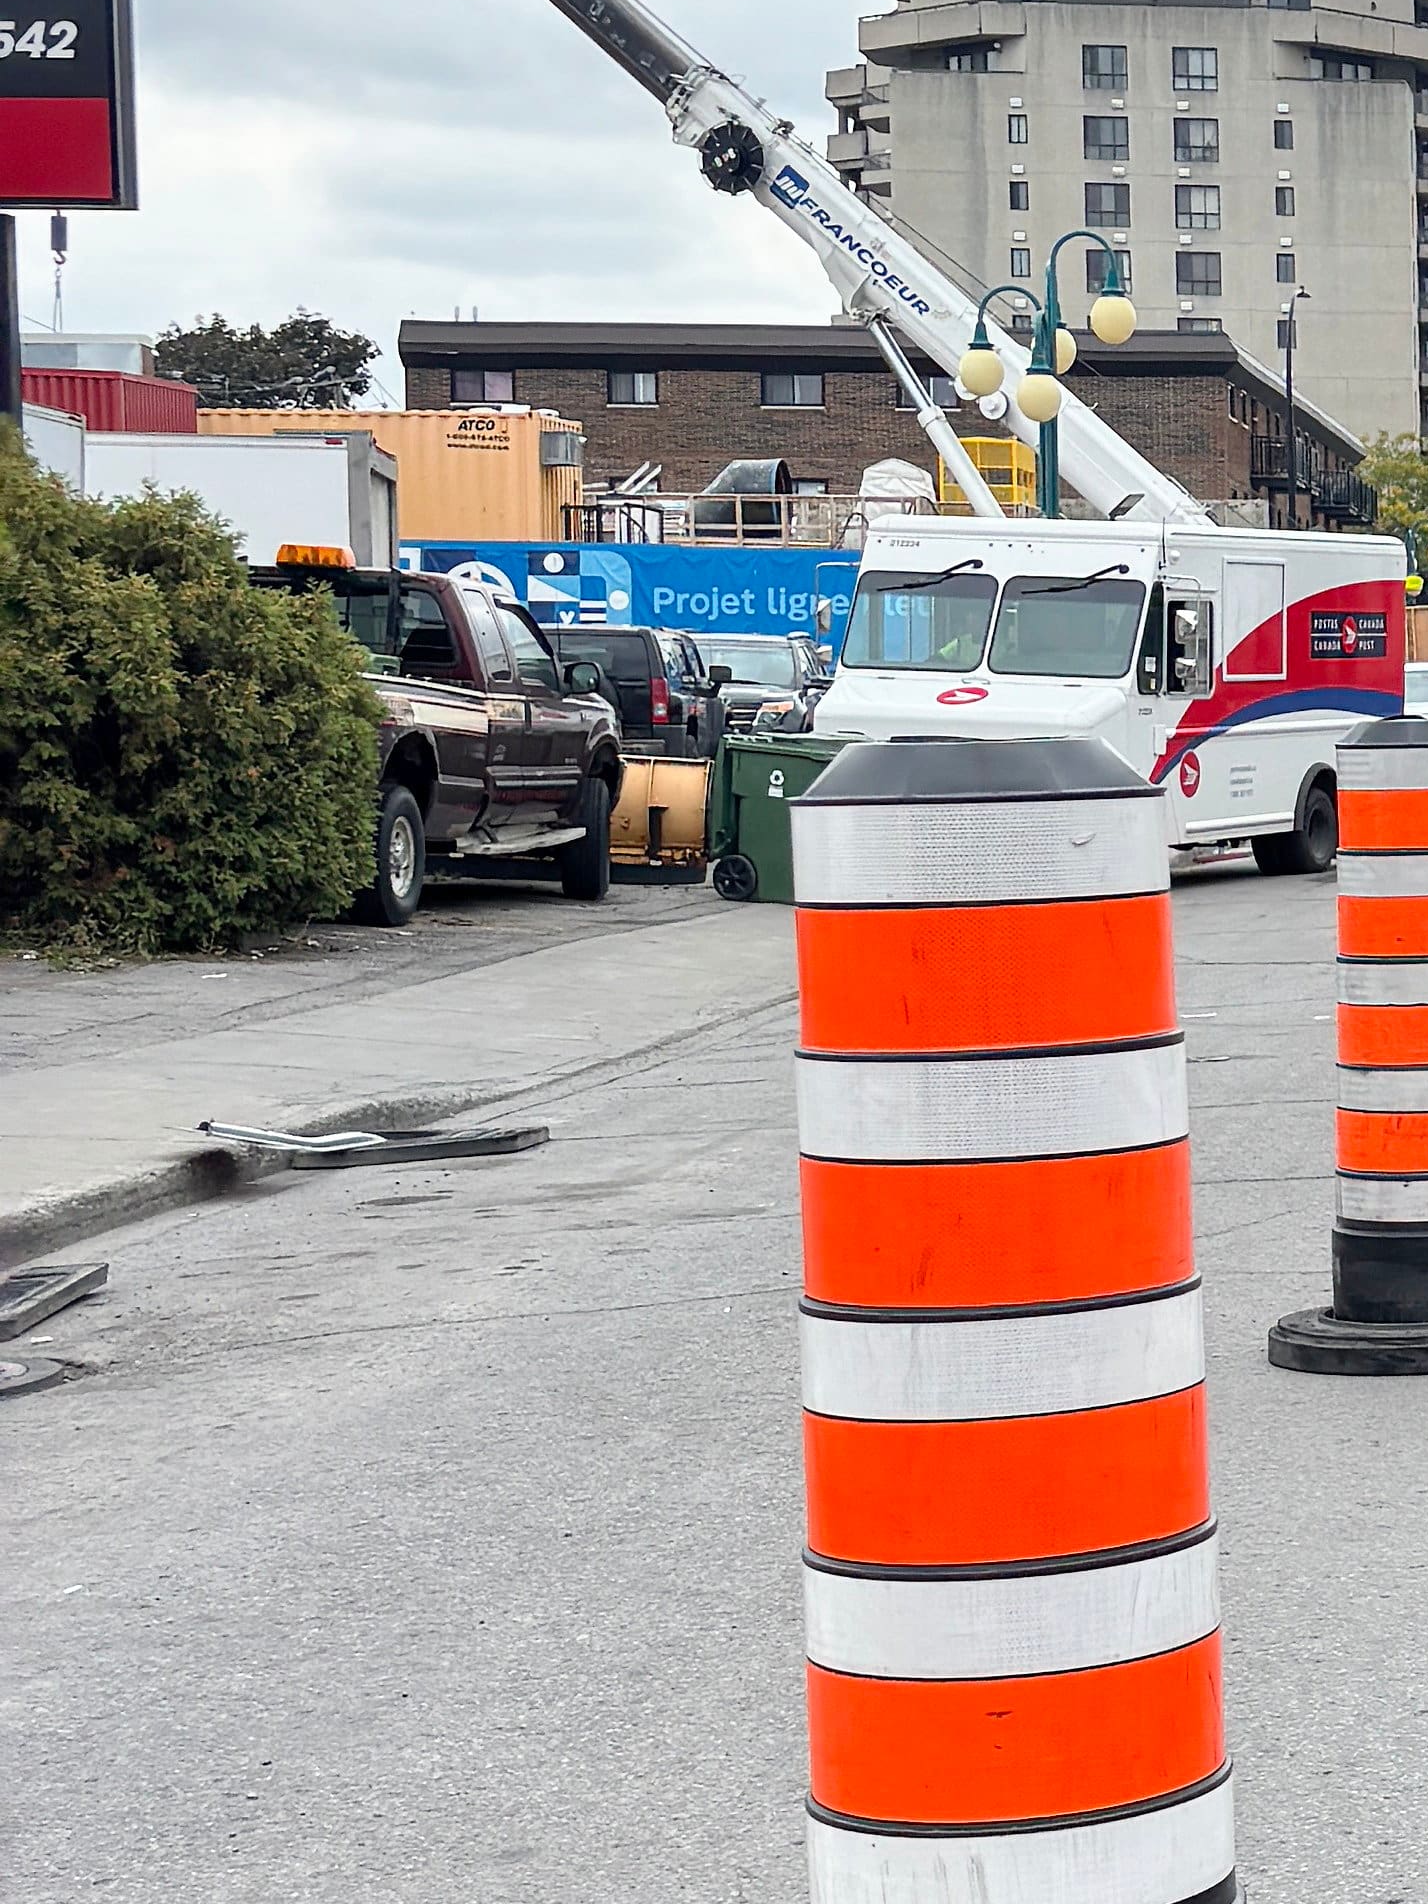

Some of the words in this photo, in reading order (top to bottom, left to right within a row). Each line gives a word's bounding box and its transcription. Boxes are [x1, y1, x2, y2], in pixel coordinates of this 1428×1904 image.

[799, 196, 931, 316] FRANCOEUR
[458, 419, 496, 431] ATCO
[653, 587, 755, 621] Projet
